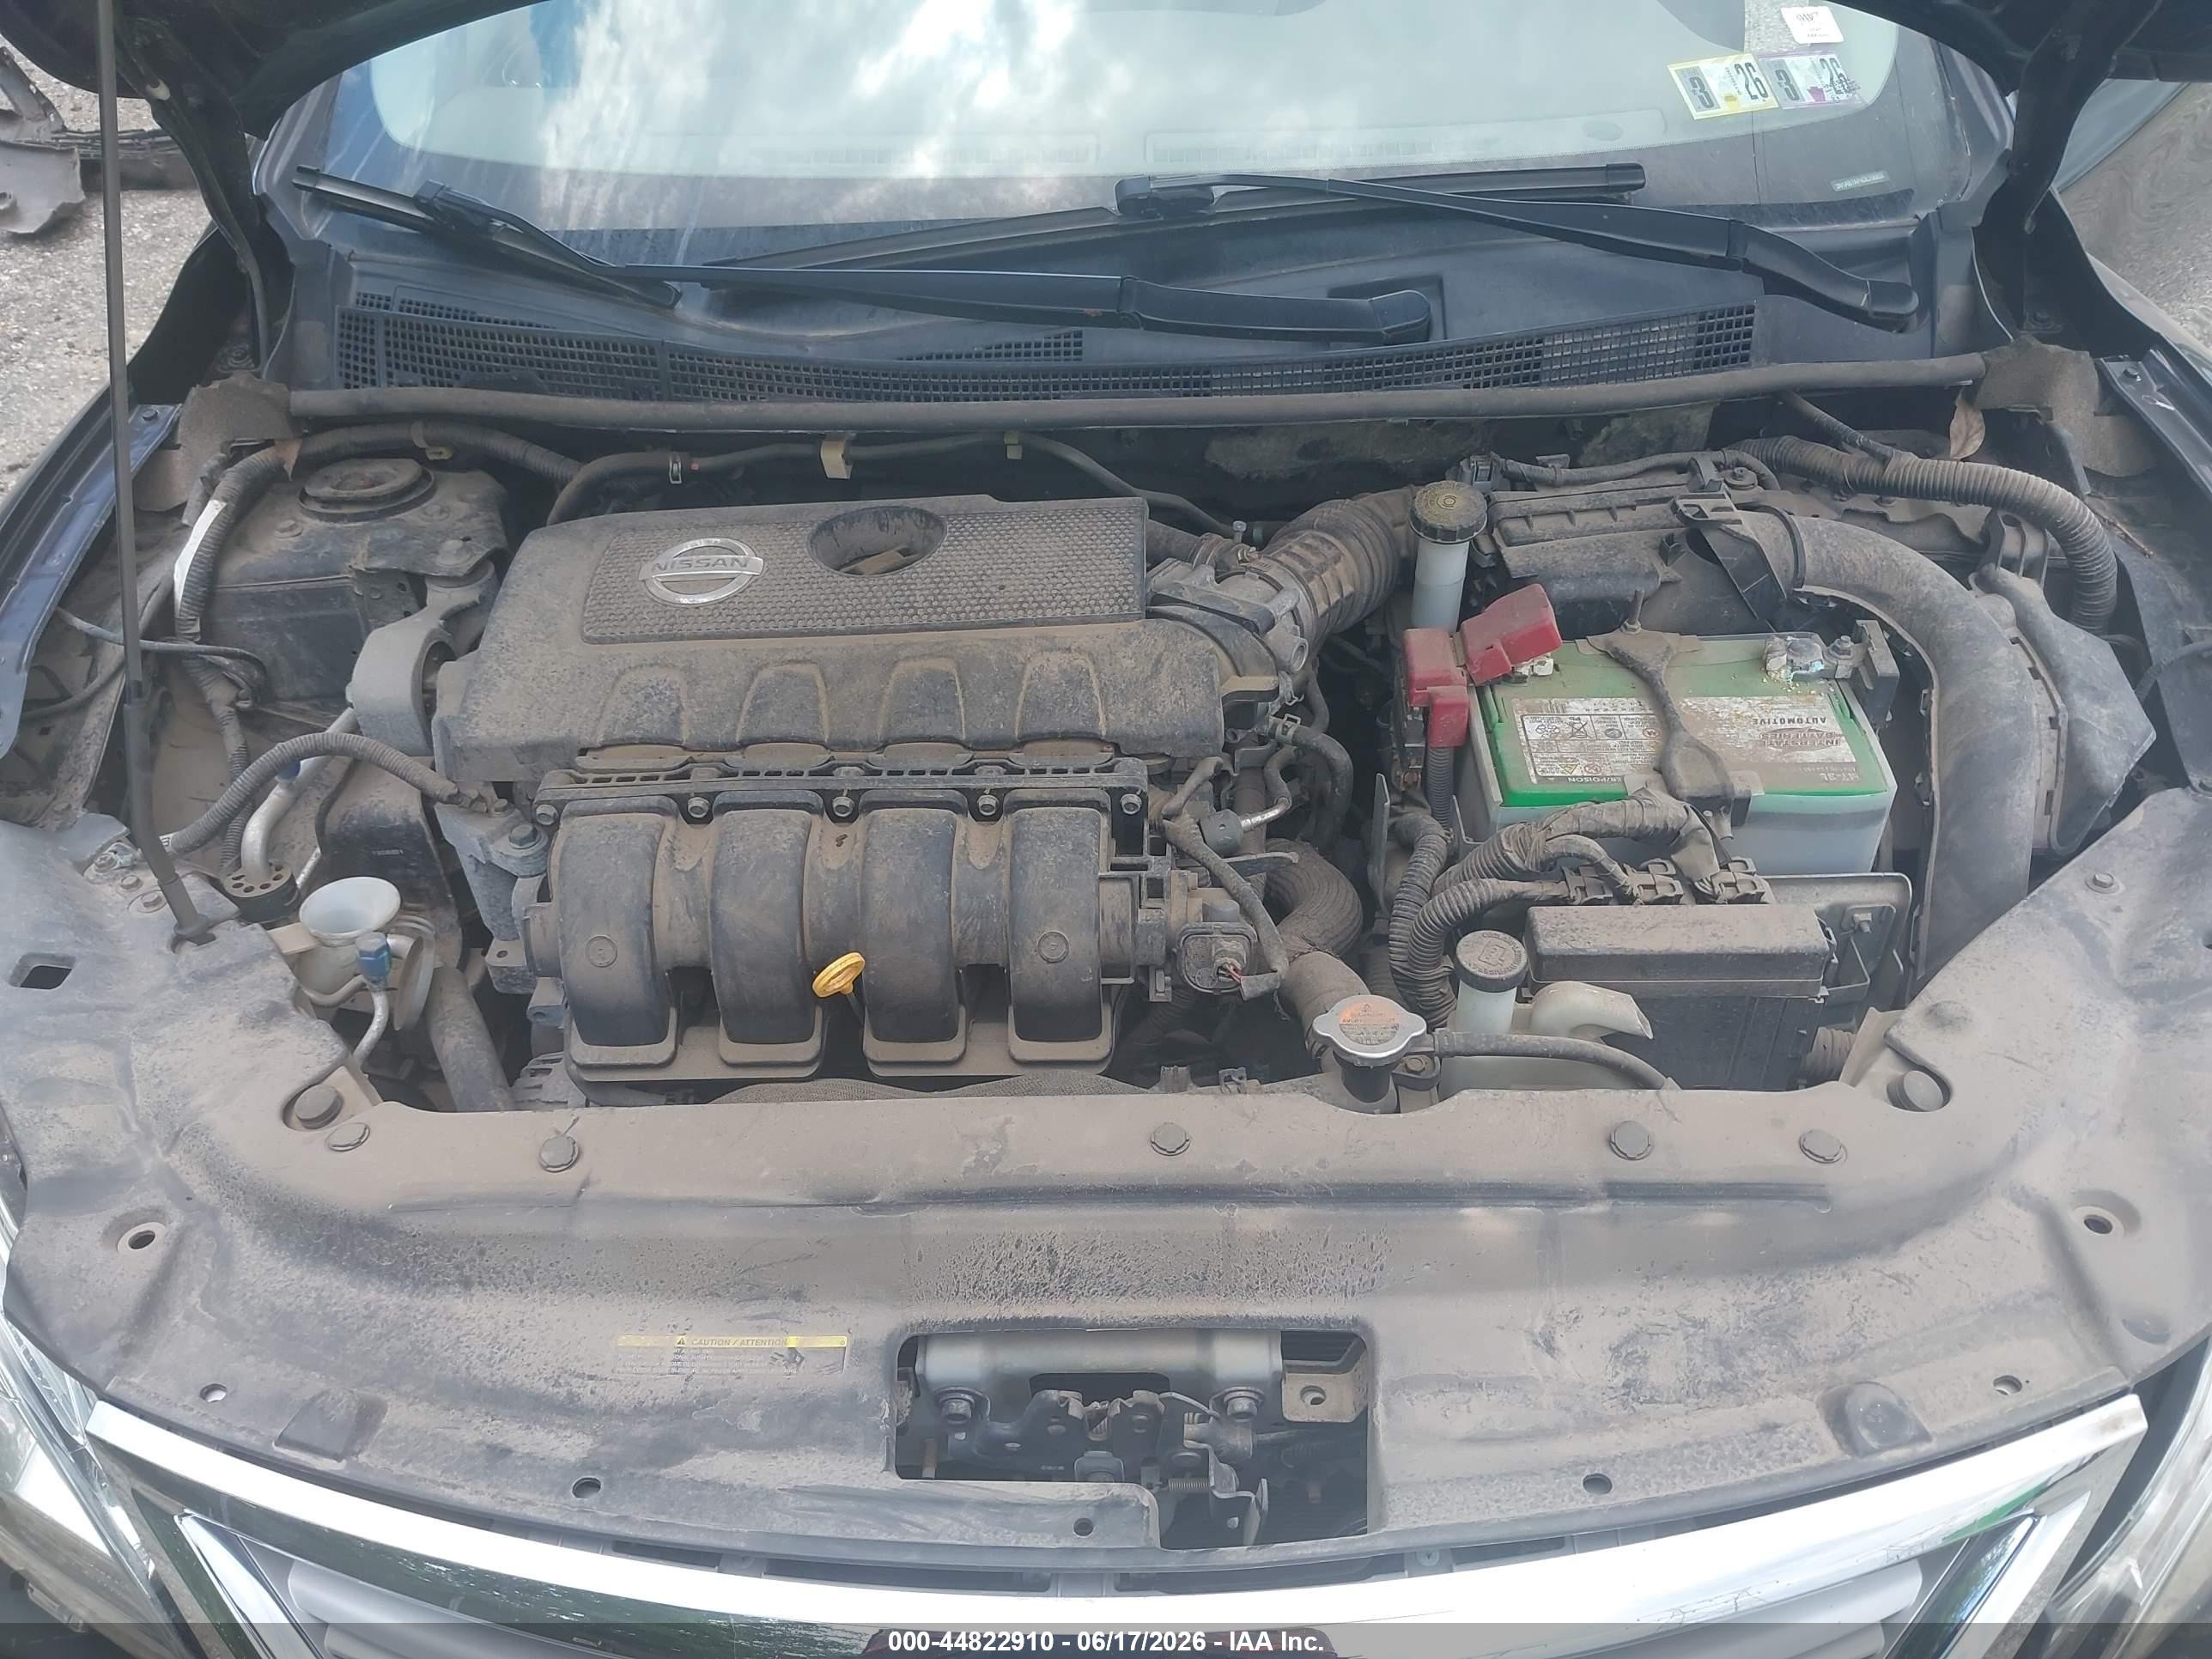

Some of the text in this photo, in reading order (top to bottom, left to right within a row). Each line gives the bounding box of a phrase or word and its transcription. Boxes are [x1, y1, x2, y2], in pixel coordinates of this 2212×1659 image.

[1689, 76, 1714, 108] 3
[1734, 62, 1768, 100] 26
[1775, 69, 1800, 101] 3
[652, 558, 749, 571] NISSAN
